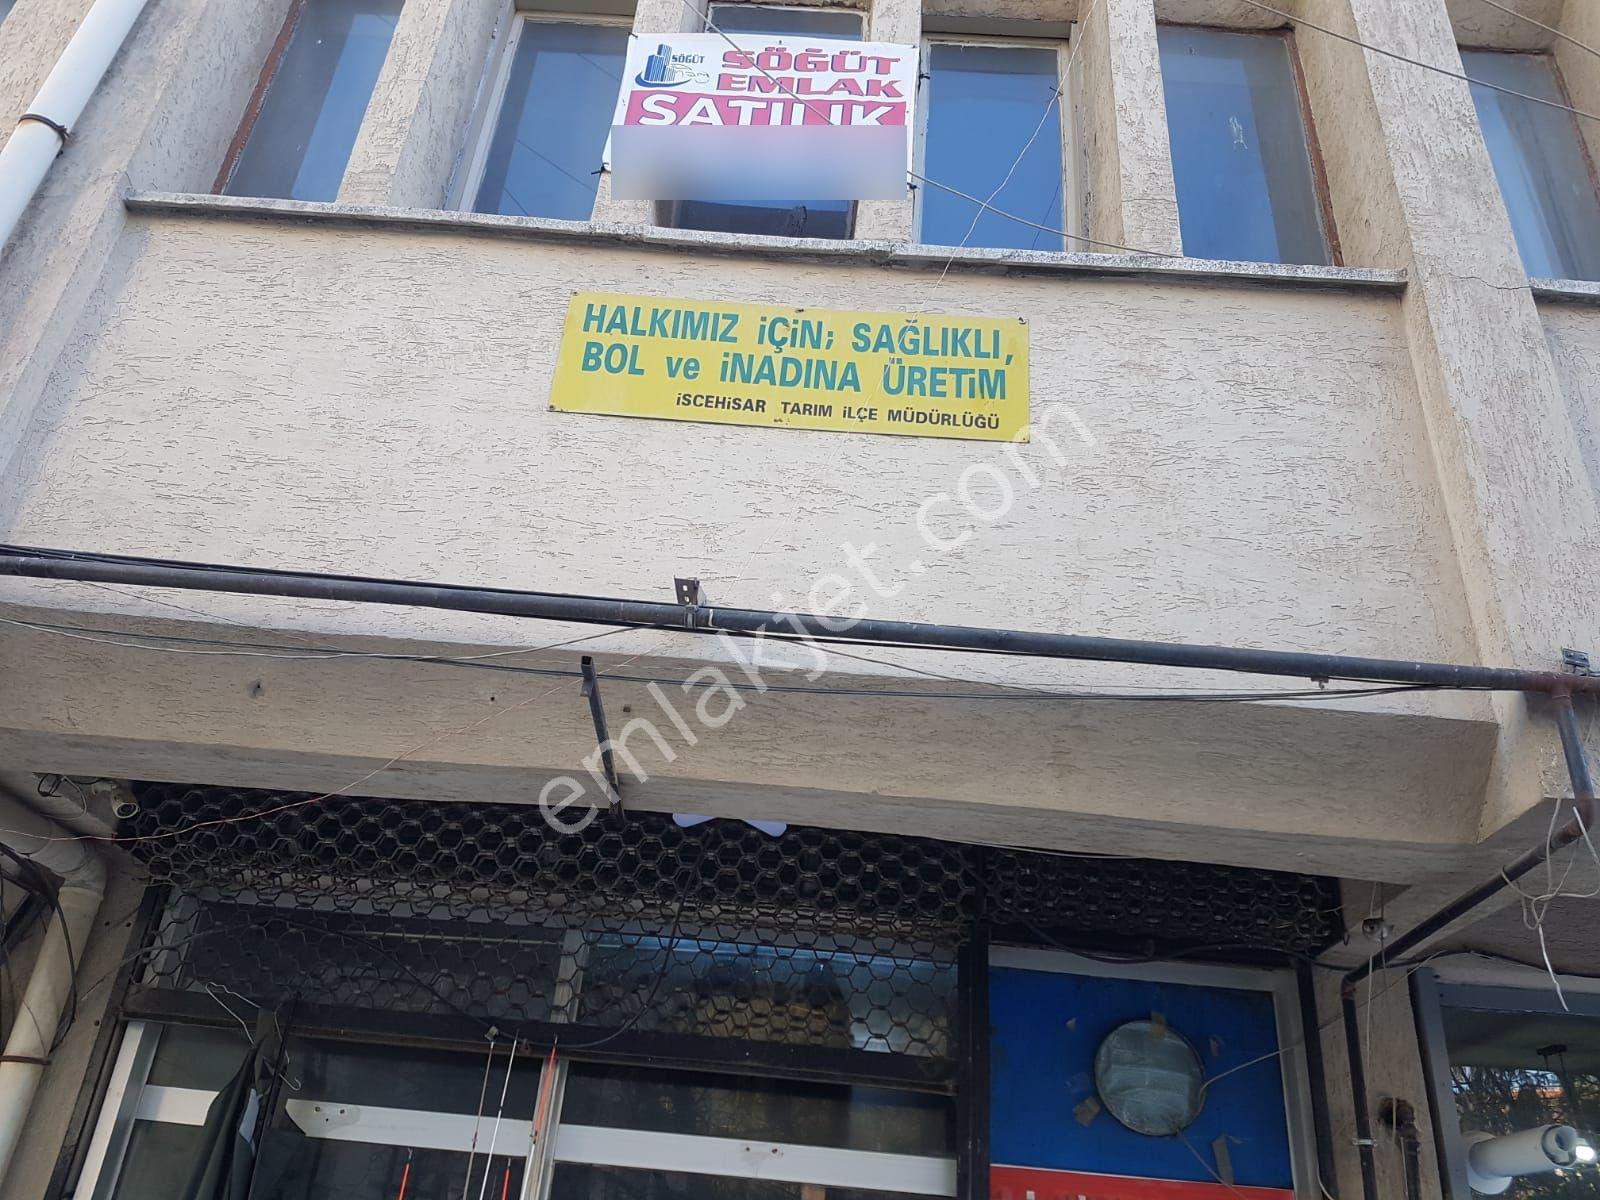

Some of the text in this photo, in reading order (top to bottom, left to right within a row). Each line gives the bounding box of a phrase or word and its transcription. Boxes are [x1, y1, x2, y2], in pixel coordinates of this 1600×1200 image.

[721, 46, 901, 75] SÖĞÜT
[717, 73, 904, 97] EMLAK
[582, 303, 739, 343] HALKIMIZ
[852, 319, 1013, 366] SAĞLIKLI,
[581, 341, 645, 376] BOL
[666, 356, 700, 379] ve
[781, 402, 833, 417] TARIM
[887, 407, 1000, 430] MÜDÜRLÜĞÜ
